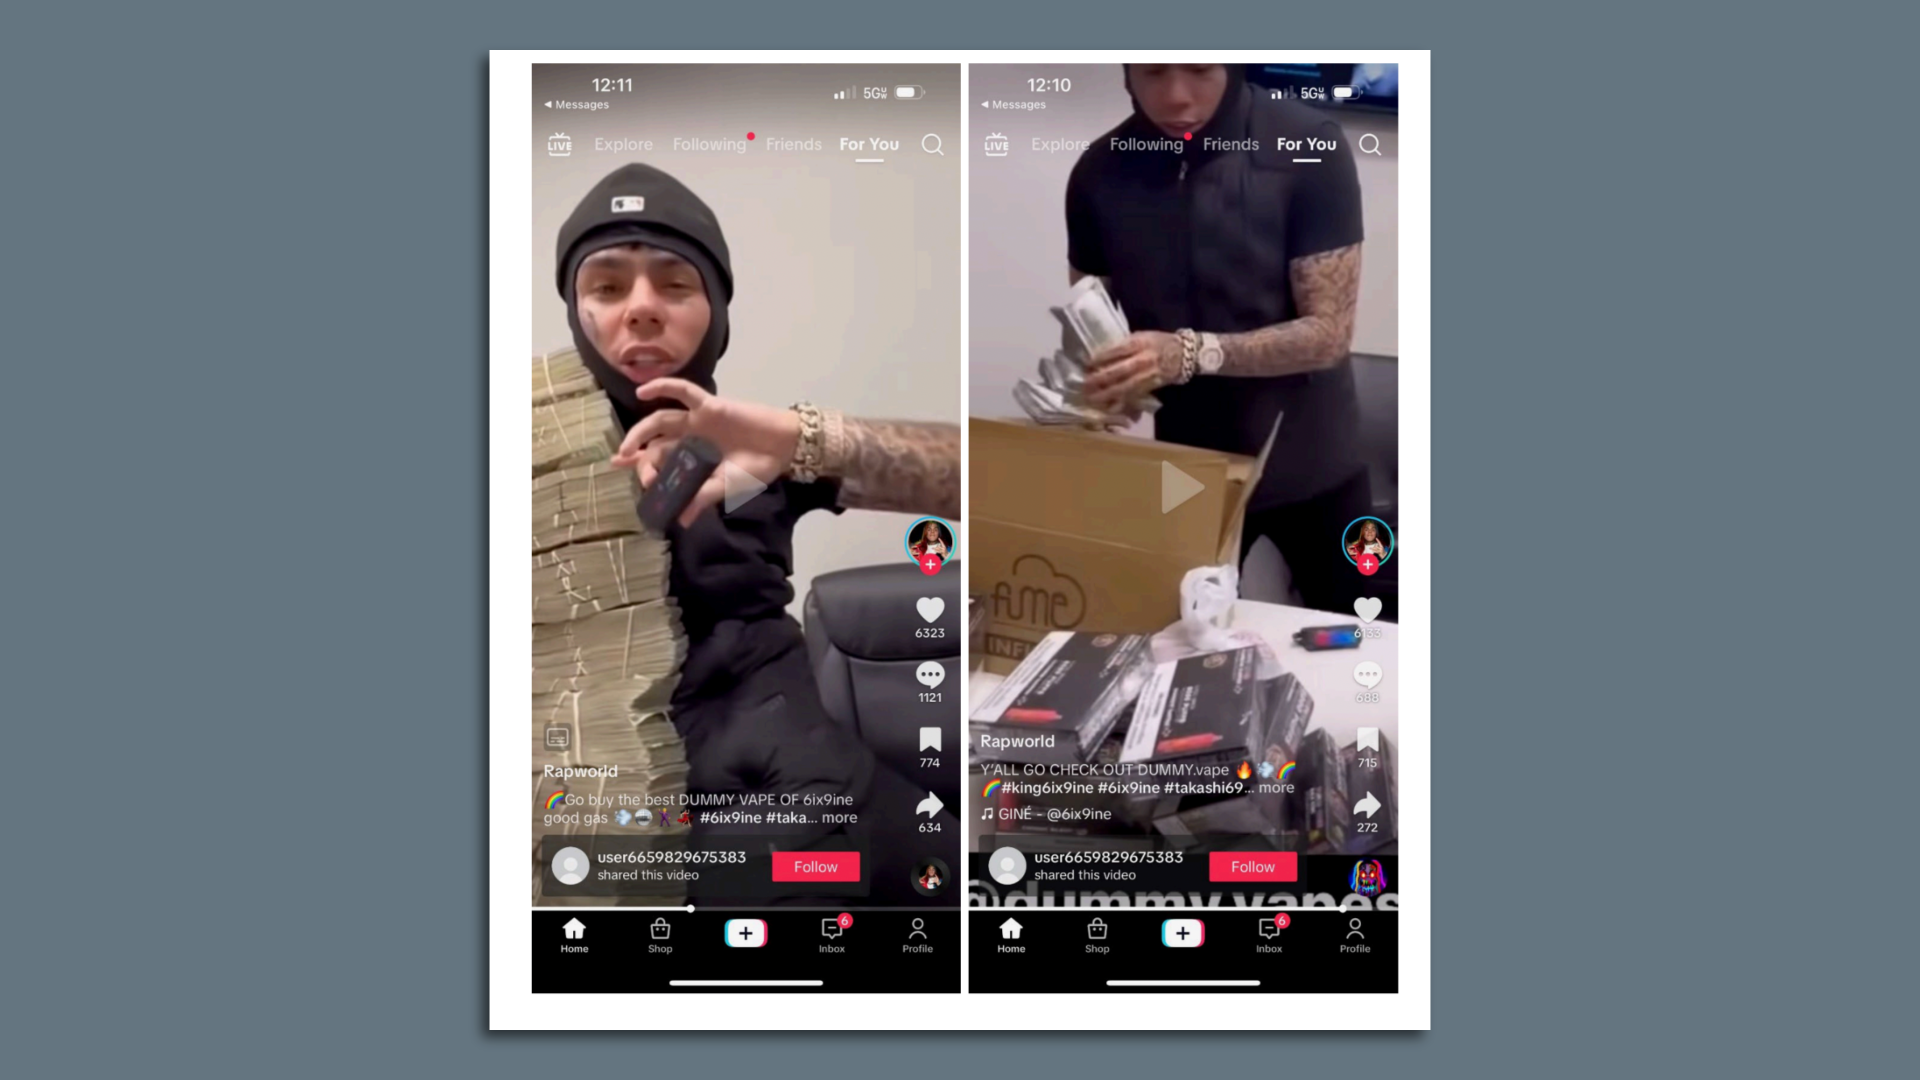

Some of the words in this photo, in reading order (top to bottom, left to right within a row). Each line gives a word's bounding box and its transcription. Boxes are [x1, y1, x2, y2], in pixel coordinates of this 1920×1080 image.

[591, 77, 634, 93] 12:11
[1027, 77, 1072, 93] 12:10
[555, 99, 610, 111] Messages
[992, 99, 1047, 111] Messages
[547, 139, 573, 152] LIVE
[594, 137, 654, 155] Explore
[673, 137, 747, 155] Following
[766, 137, 823, 152] Friends
[839, 137, 866, 152] For
[869, 137, 900, 152] You
[984, 139, 1009, 152] LIVE
[1031, 137, 1091, 155] Explore
[1110, 137, 1184, 155] Following
[1203, 137, 1260, 152] Friends
[1276, 137, 1303, 152] For
[1307, 137, 1337, 152] You
[915, 628, 946, 639] 6323
[1353, 628, 1382, 639] 6133
[918, 692, 942, 703] 1121
[1355, 692, 1380, 703] 688
[981, 734, 1055, 751] Rapworld
[919, 757, 941, 768] 774
[1357, 757, 1378, 768] 715
[543, 764, 619, 781] Rapworld
[1023, 763, 1046, 777] GO
[1049, 763, 1098, 777] CHECK
[1102, 763, 1134, 777] OUT
[1137, 763, 1230, 780] DUMMY.vape
[1001, 780, 1094, 797] #king6ix9ine
[1098, 781, 1161, 795] #6ix9ine
[1258, 783, 1295, 795] more
[564, 793, 585, 807] Go
[588, 793, 614, 810] buy
[618, 793, 641, 807] the
[644, 793, 676, 807] best
[678, 793, 737, 807] DUMMY
[739, 793, 776, 807] VAPE
[779, 793, 799, 807] OF
[803, 793, 854, 807] 6ix9ine
[543, 811, 581, 828] good
[583, 813, 609, 828] gas
[699, 811, 763, 825] #6ix9ine
[821, 813, 858, 825] more
[998, 805, 1032, 820] GINÉ
[1046, 807, 1112, 823] @6ix9ine
[918, 822, 942, 833] 634
[1357, 822, 1379, 833] 272
[597, 851, 747, 865] user6659829675383
[1034, 851, 1184, 865] user6659829675383
[794, 860, 839, 874] Follow
[1231, 860, 1276, 874] Follow
[597, 869, 639, 882] shared
[641, 869, 664, 882] this
[666, 869, 700, 882] video
[1034, 869, 1075, 882] shared
[1078, 869, 1100, 882] this
[1103, 869, 1137, 882] video
[840, 915, 850, 927] 6
[1277, 915, 1287, 927] 6
[560, 944, 589, 954] Home
[648, 944, 673, 956] Shop
[818, 944, 846, 954] Inbox
[902, 944, 934, 954] Profile
[997, 944, 1026, 954] Home
[1085, 944, 1110, 956] Shop
[1256, 944, 1283, 954] Inbox
[1339, 944, 1371, 954] Profile
